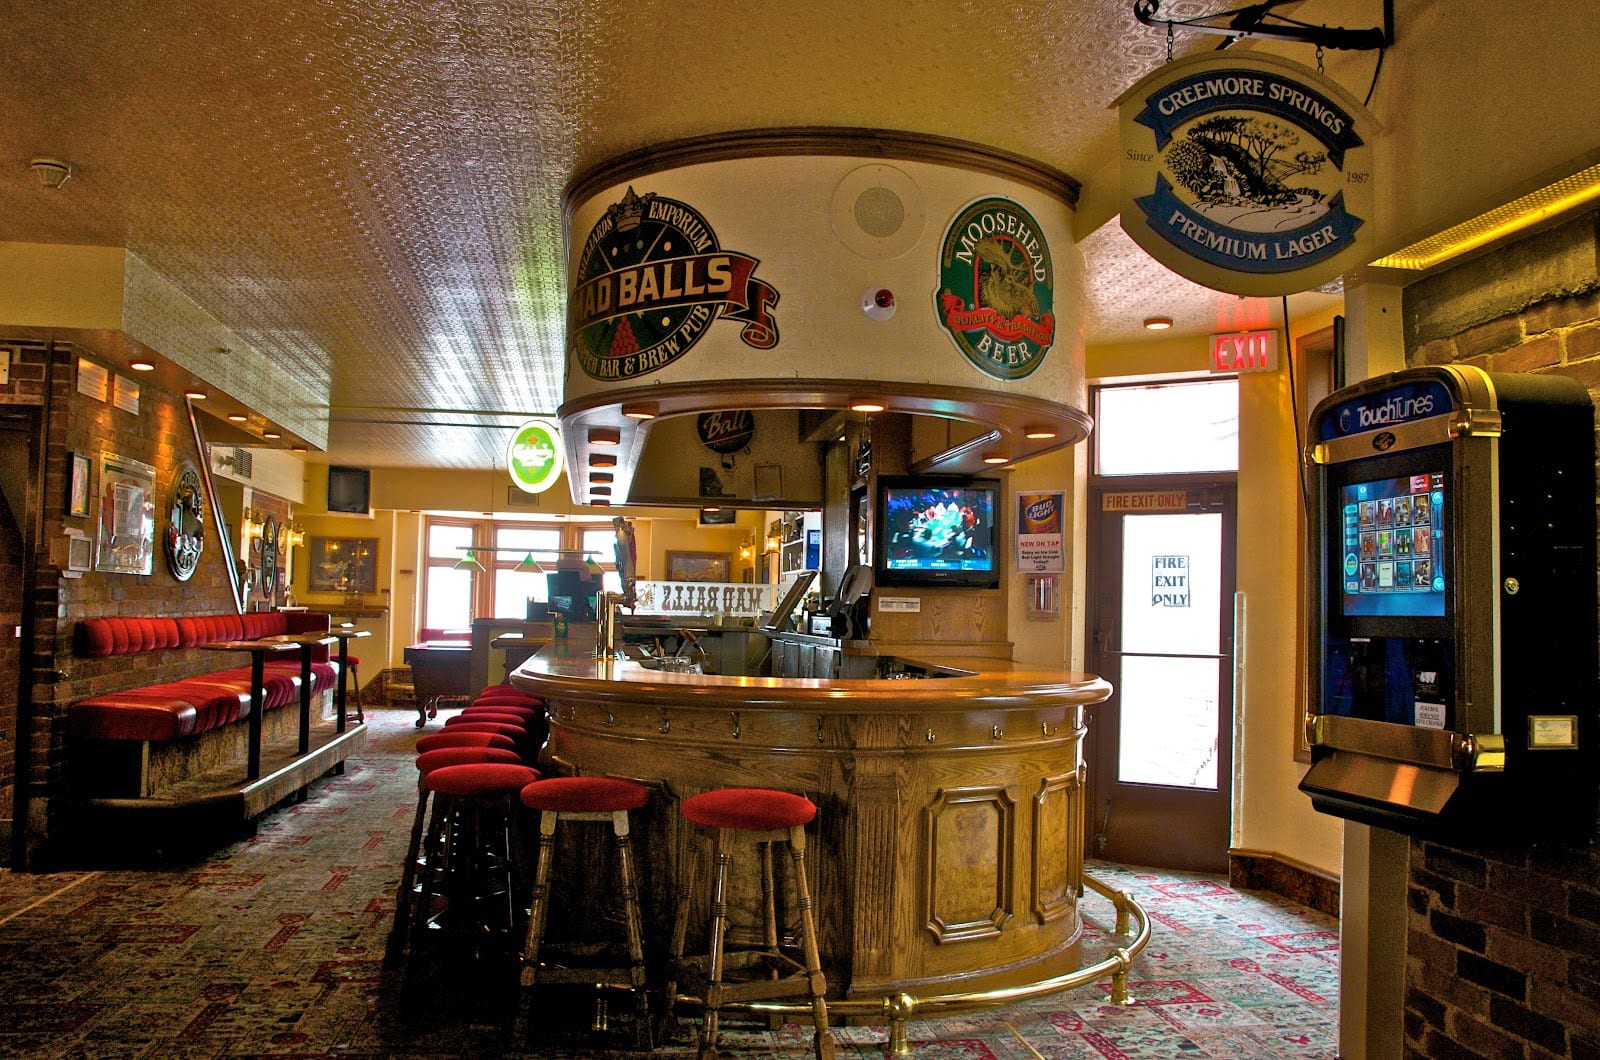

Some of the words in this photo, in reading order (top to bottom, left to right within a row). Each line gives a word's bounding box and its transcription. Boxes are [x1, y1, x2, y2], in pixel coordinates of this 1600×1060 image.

[1157, 77, 1265, 116] CREEMORE
[1268, 82, 1345, 135] SPRINGS
[1125, 149, 1154, 162] Since
[1346, 172, 1369, 184] 1987
[578, 214, 613, 281] BILLIARDS
[649, 201, 712, 252] EMPORIUM
[955, 212, 1046, 282] MOOSEHEAD
[1168, 209, 1267, 261] PREMIUM
[1275, 225, 1339, 260] LAGER
[618, 256, 732, 307] BALLS
[600, 359, 620, 378] BAR
[623, 357, 636, 375] &
[638, 337, 681, 371] BREW
[680, 305, 710, 344] PUB
[977, 334, 1032, 364] BEER
[1215, 333, 1271, 370] EXIT
[1357, 394, 1434, 427] TouchTunes
[1029, 503, 1055, 519] LIGHT
[1032, 499, 1053, 512] BUD
[1106, 495, 1129, 509] FIRE
[1131, 494, 1155, 508] EXIT
[1157, 493, 1185, 508] ONLY
[1154, 557, 1186, 569] FIRE
[1155, 575, 1186, 587] EXIT
[1153, 594, 1188, 605] ONLY
